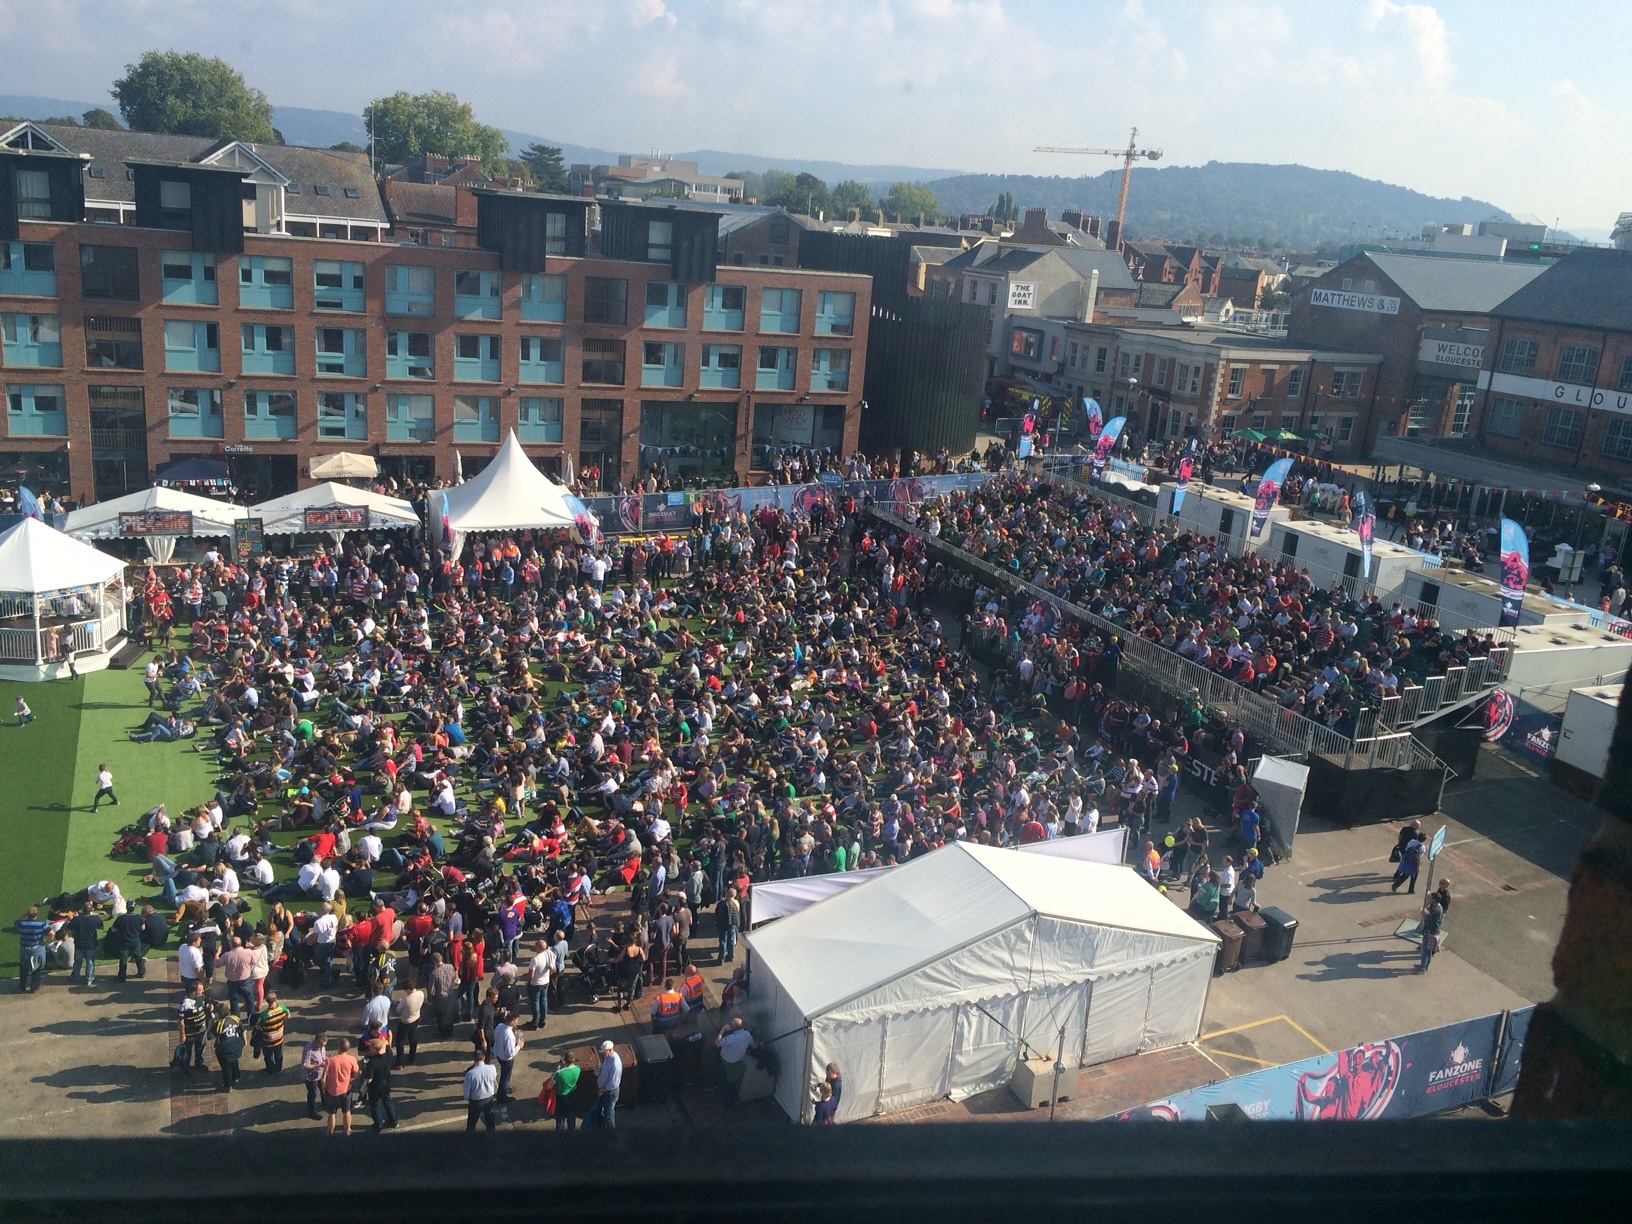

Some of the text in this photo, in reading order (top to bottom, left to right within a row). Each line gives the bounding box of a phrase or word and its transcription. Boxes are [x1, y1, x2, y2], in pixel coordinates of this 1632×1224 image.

[1312, 290, 1385, 310] MATTHEWS &
[1428, 1058, 1483, 1082] FANZONE
[1426, 1074, 1482, 1094] GLOUCESTER
